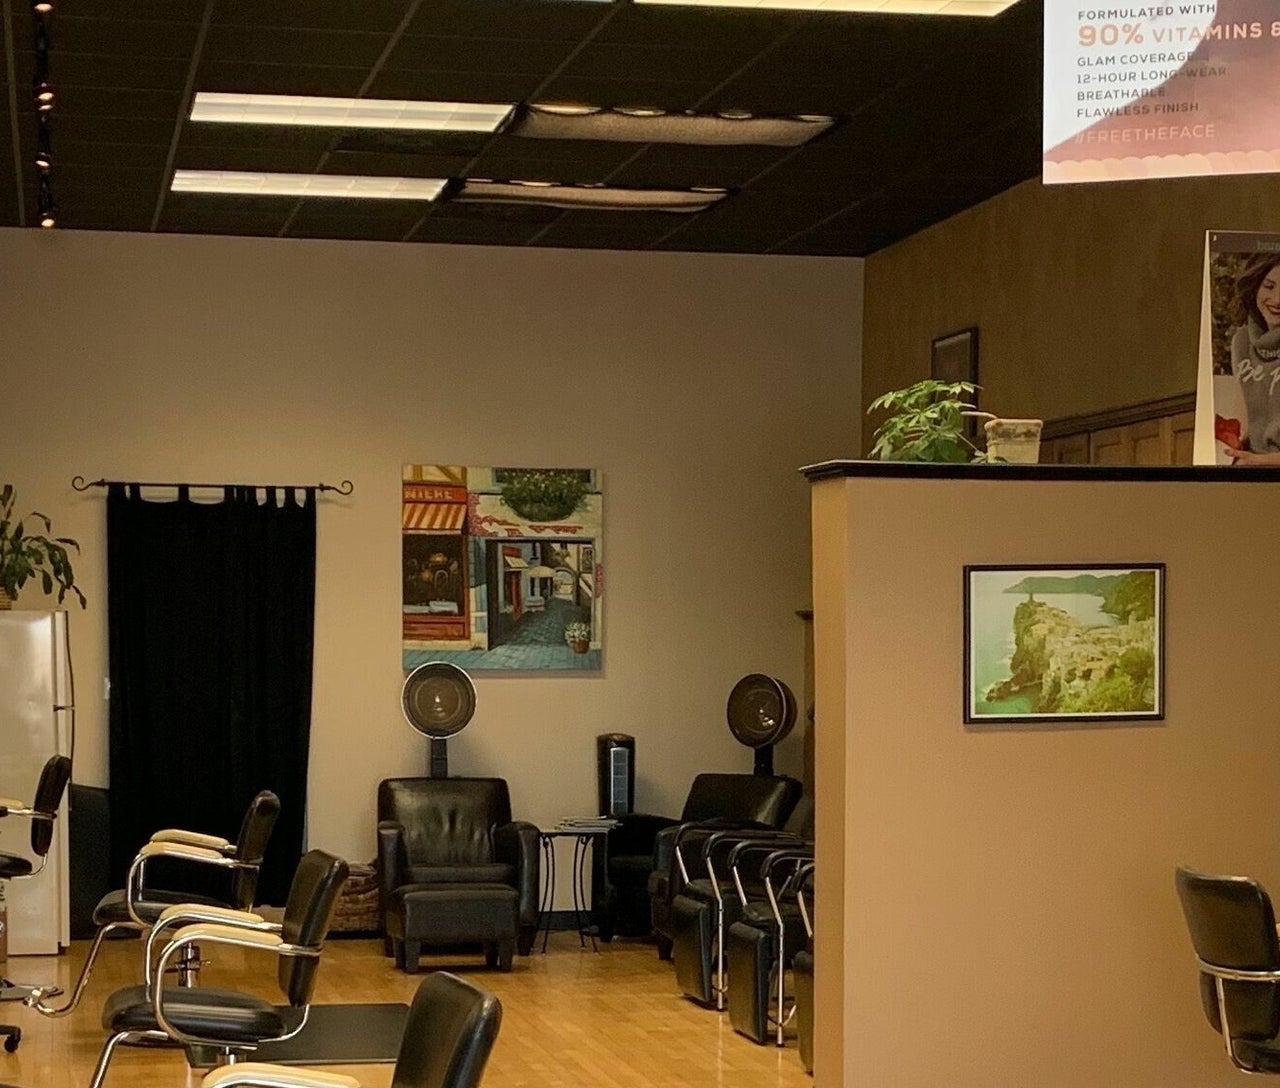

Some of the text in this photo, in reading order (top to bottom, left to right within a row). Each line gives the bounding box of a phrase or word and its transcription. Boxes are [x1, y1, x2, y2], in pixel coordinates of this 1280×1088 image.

[1078, 4, 1215, 20] FORMULATED WITH
[1078, 23, 1144, 47] 90%
[1153, 22, 1263, 43] VITAMINS
[1078, 52, 1194, 67] GLAM COVERAGE
[1077, 67, 1227, 84] 12-HOUR LONG-WEAR
[1077, 87, 1166, 101] BREATHABLE
[1077, 102, 1200, 118] FLAWLESS FINISH
[1075, 124, 1216, 144] #FREETHEFACE
[1236, 359, 1264, 383] Be
